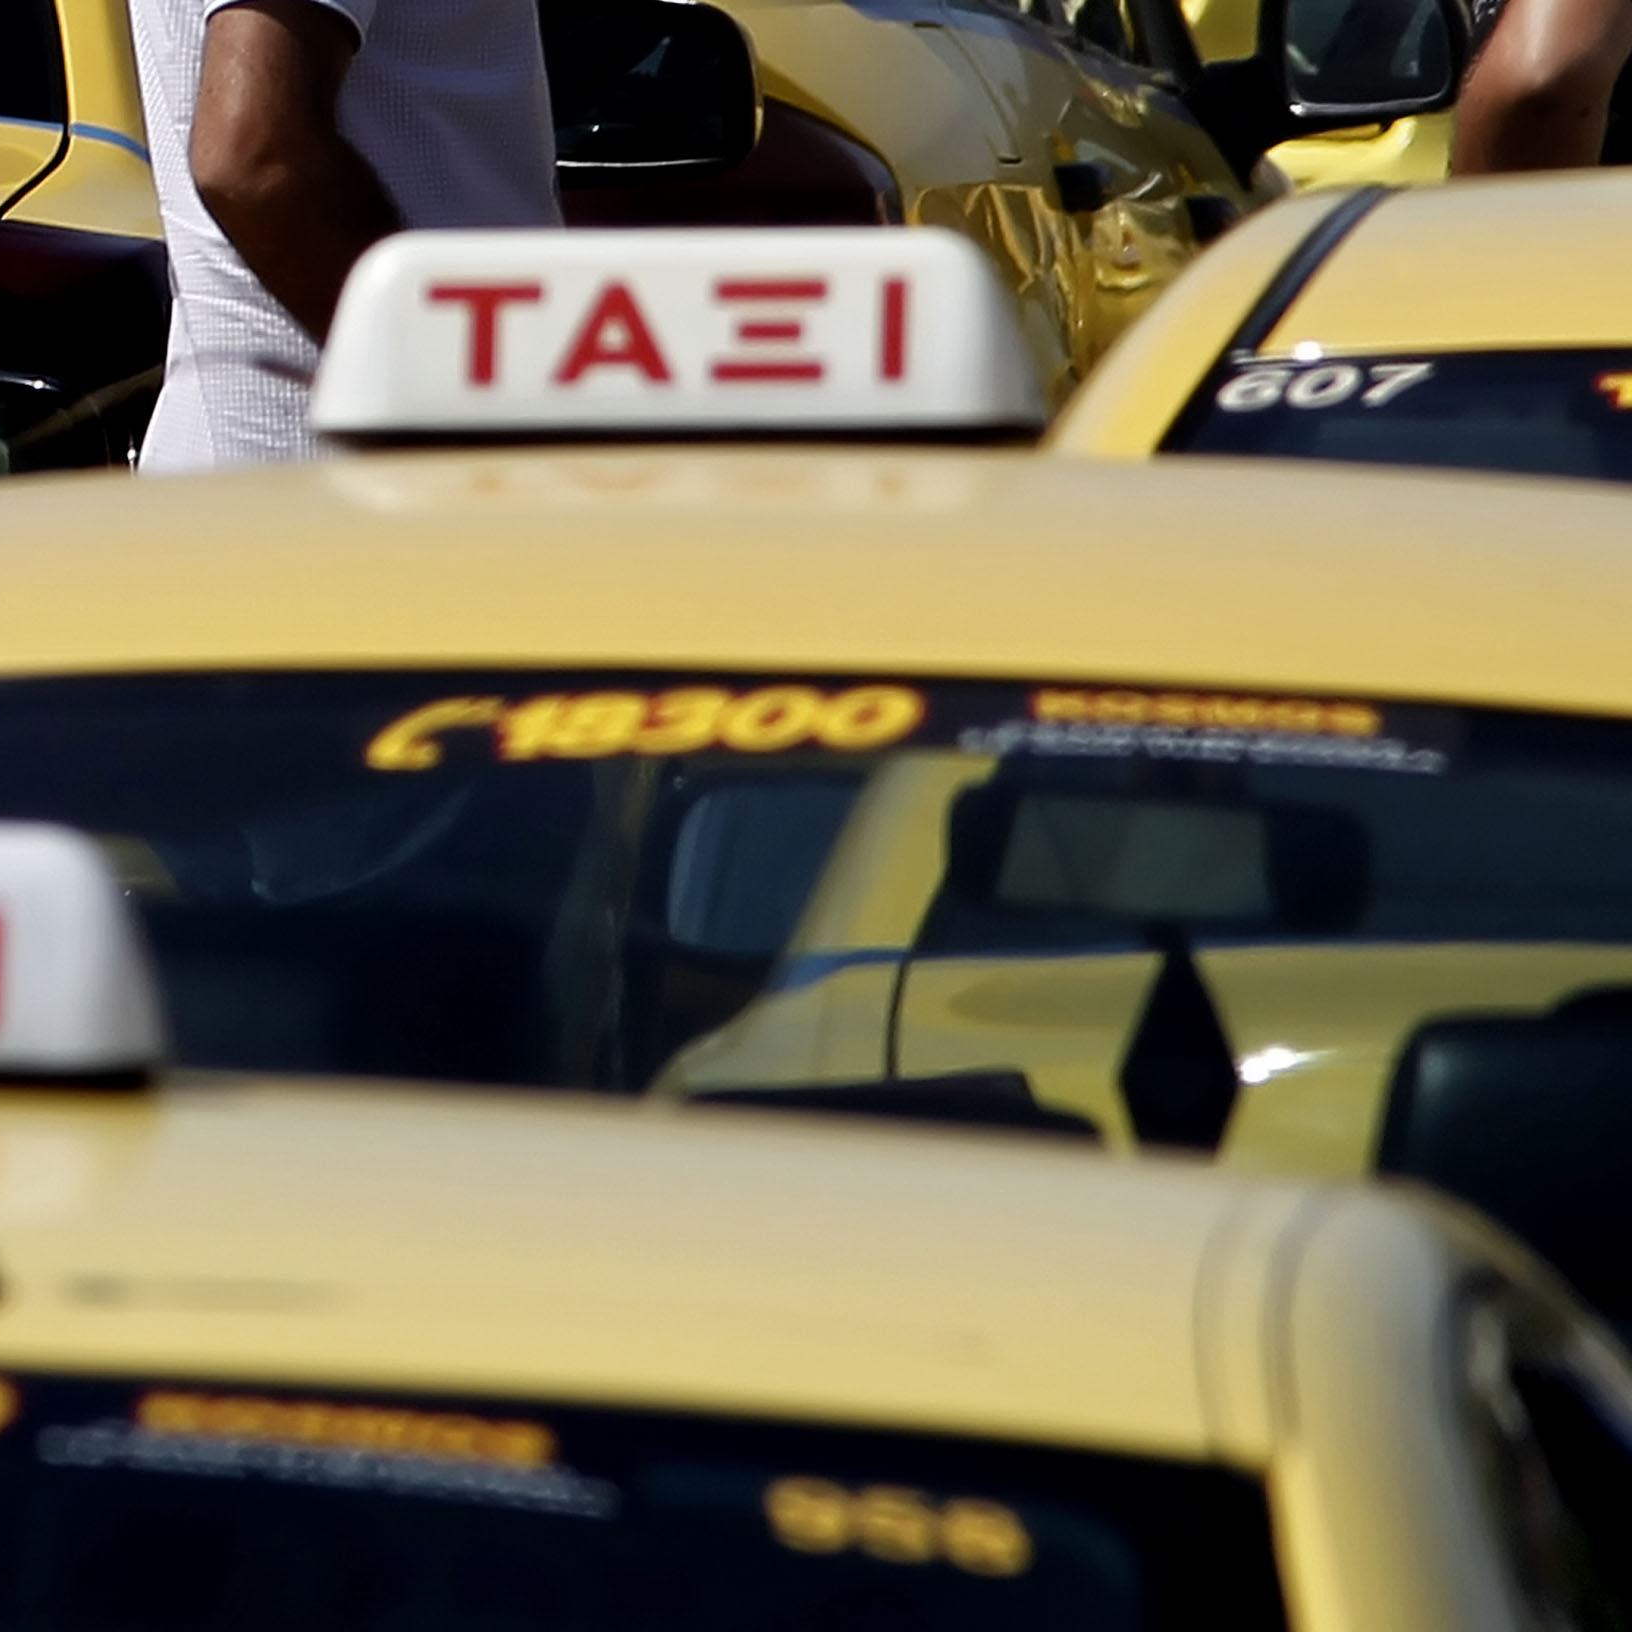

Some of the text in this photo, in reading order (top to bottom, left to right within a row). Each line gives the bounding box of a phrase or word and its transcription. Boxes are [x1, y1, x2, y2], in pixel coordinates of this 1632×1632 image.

[426, 278, 909, 387] ΤΑΞΙ
[1216, 362, 1434, 413] 607
[498, 684, 925, 761] 18300
